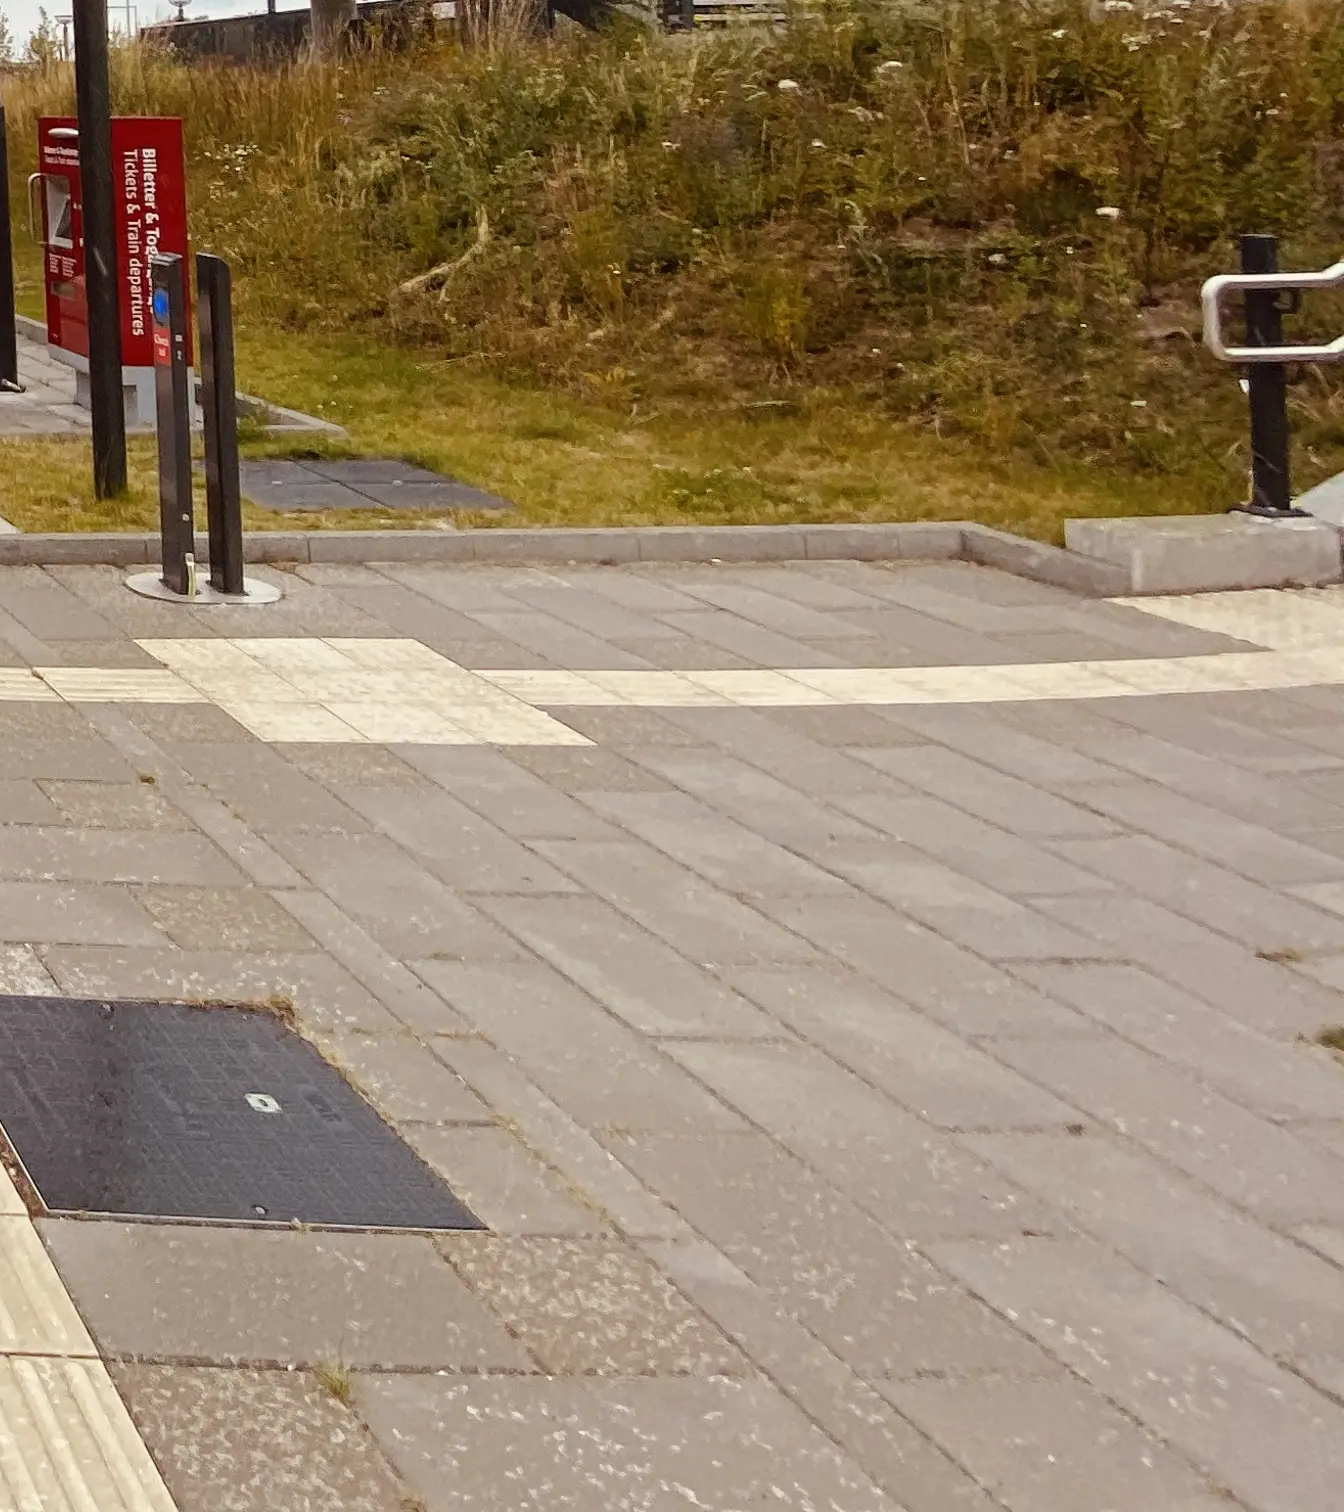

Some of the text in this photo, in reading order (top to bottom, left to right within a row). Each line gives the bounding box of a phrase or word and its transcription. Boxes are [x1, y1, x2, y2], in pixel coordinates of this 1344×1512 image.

[142, 148, 158, 209] Billetter
[123, 148, 144, 336] Tickets & Train departures
[145, 212, 159, 224] &
